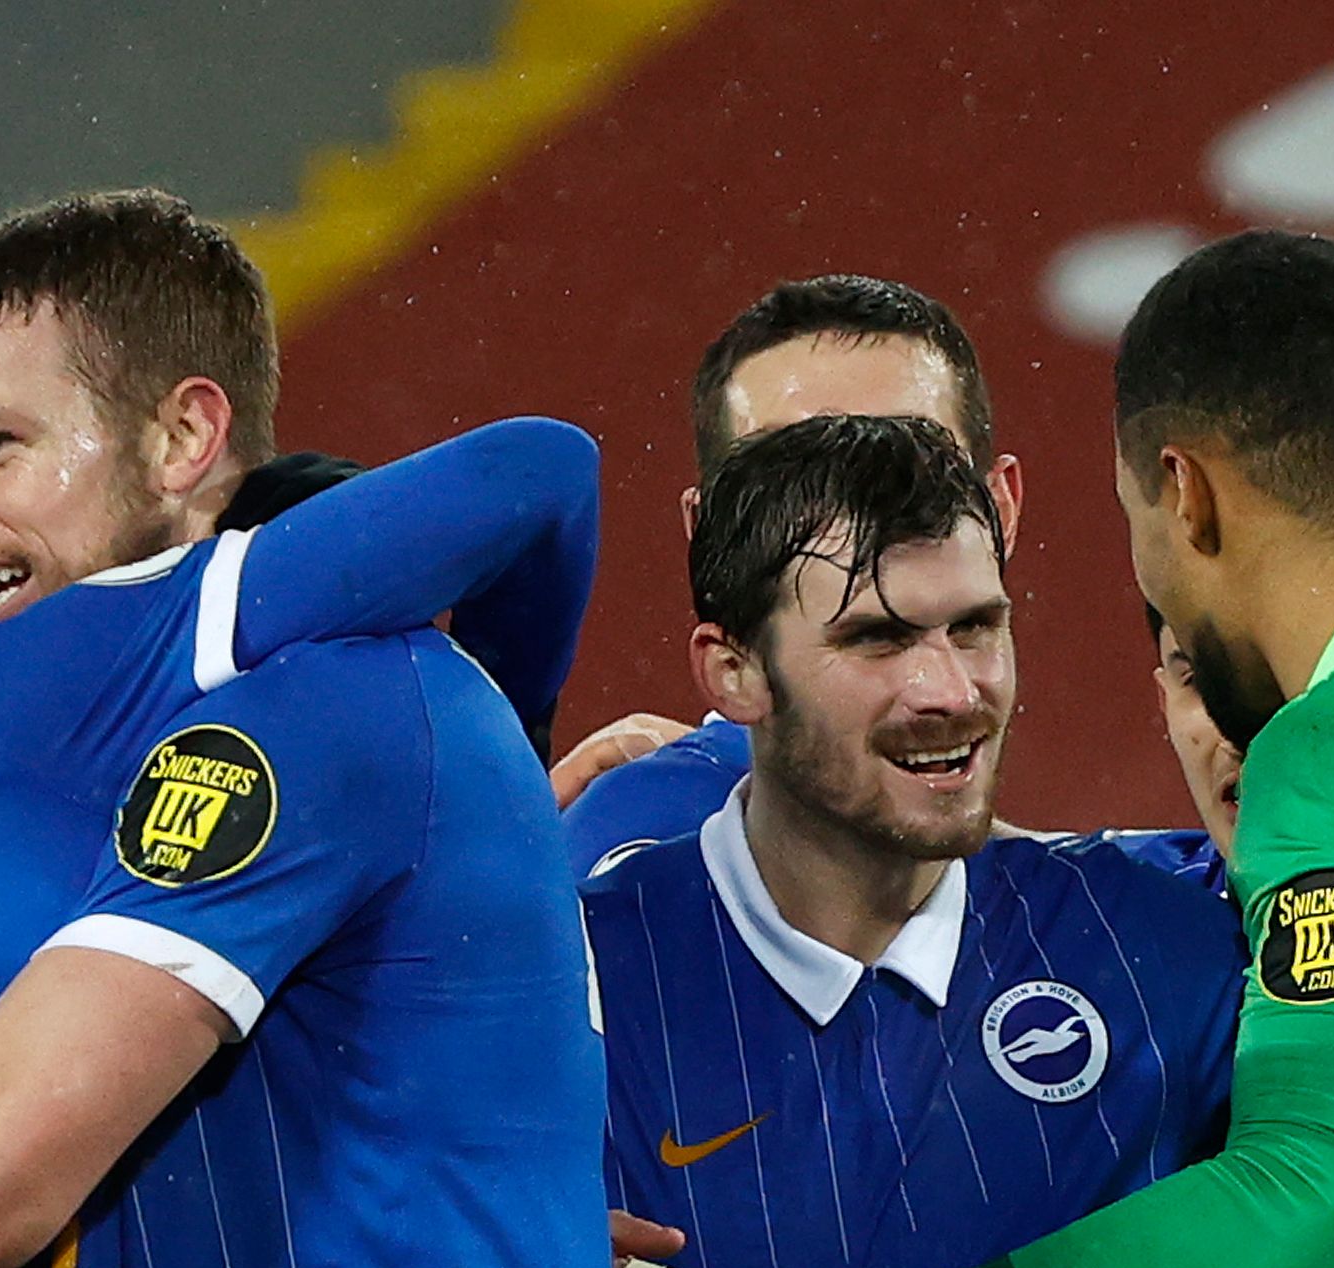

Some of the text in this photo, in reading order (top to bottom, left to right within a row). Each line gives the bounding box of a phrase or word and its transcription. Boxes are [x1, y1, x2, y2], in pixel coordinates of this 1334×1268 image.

[149, 745, 258, 796] SNICKERS
[154, 788, 214, 838] UK
[1041, 1078, 1086, 1099] ALBION
